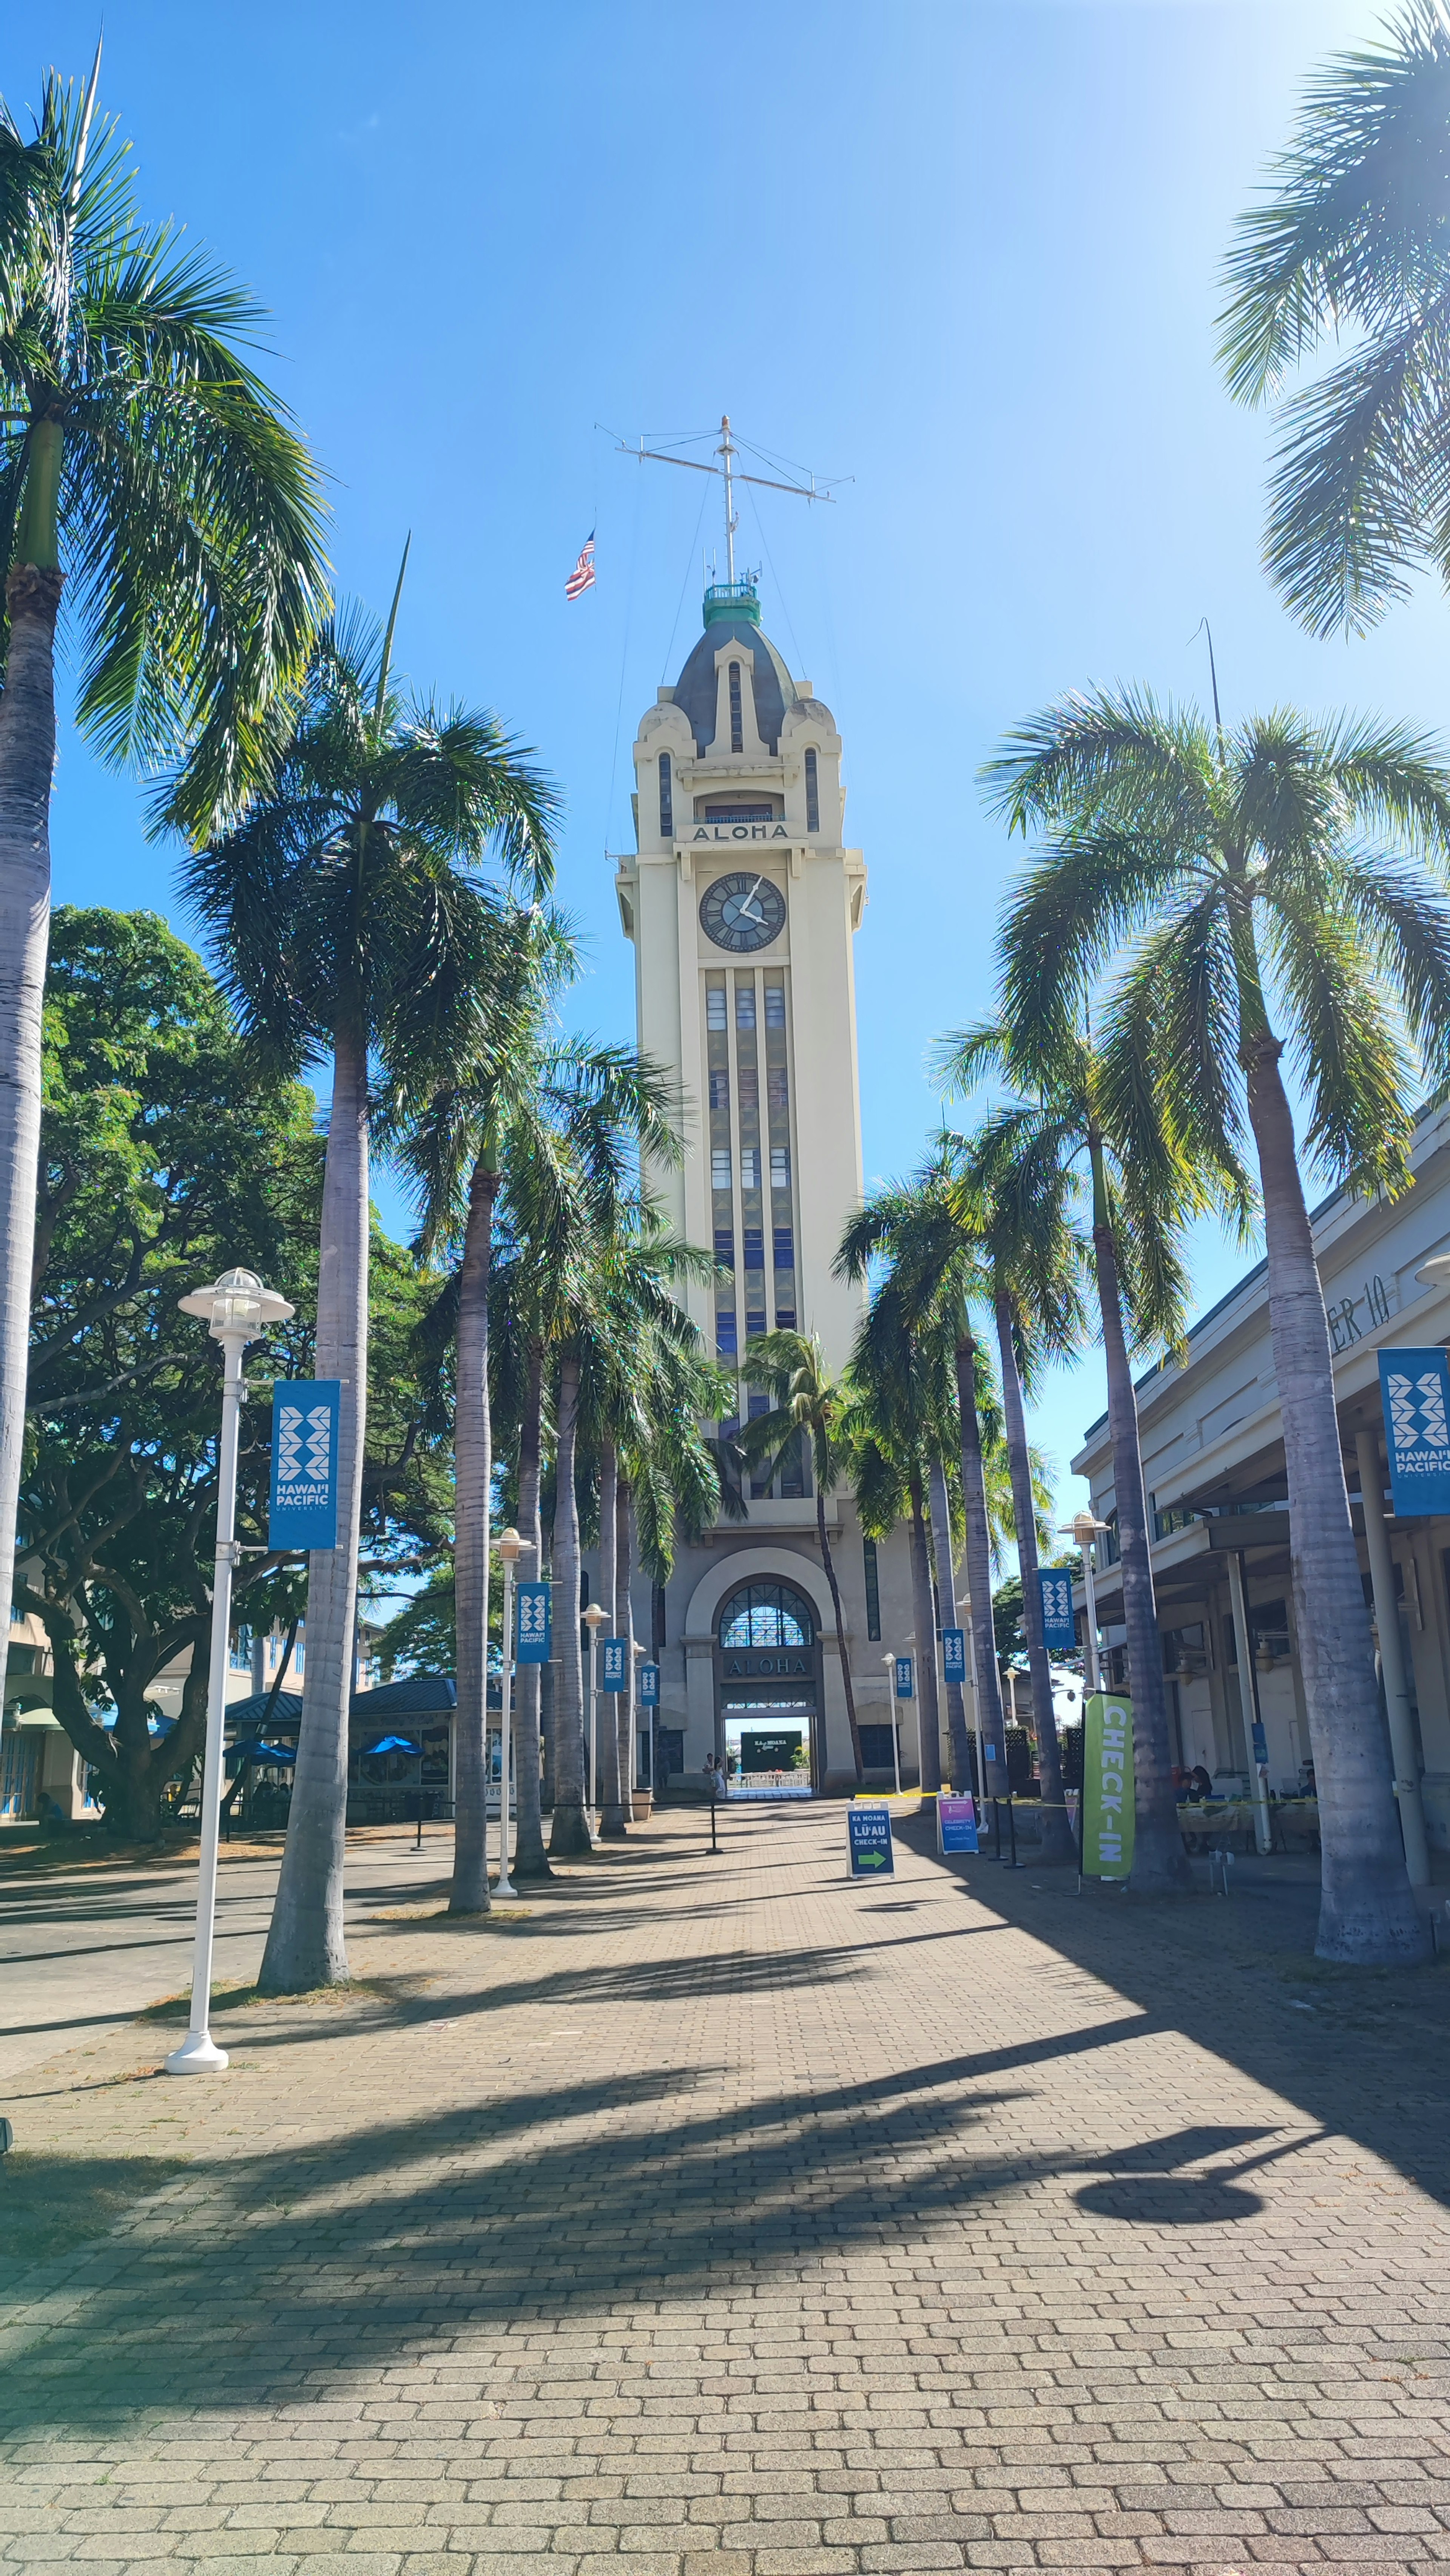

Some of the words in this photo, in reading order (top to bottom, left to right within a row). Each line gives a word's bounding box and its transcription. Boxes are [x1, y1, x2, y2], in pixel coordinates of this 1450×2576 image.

[693, 825, 788, 841] ALOHA
[1364, 1274, 1387, 1326] 10
[1396, 1461, 1450, 1473] PACIFIC
[277, 1484, 329, 1495] HAWAI‘I
[276, 1494, 329, 1506] PACIFIC
[729, 1658, 806, 1675] ALOHA
[1099, 1706, 1127, 1862] CHECK-IN
